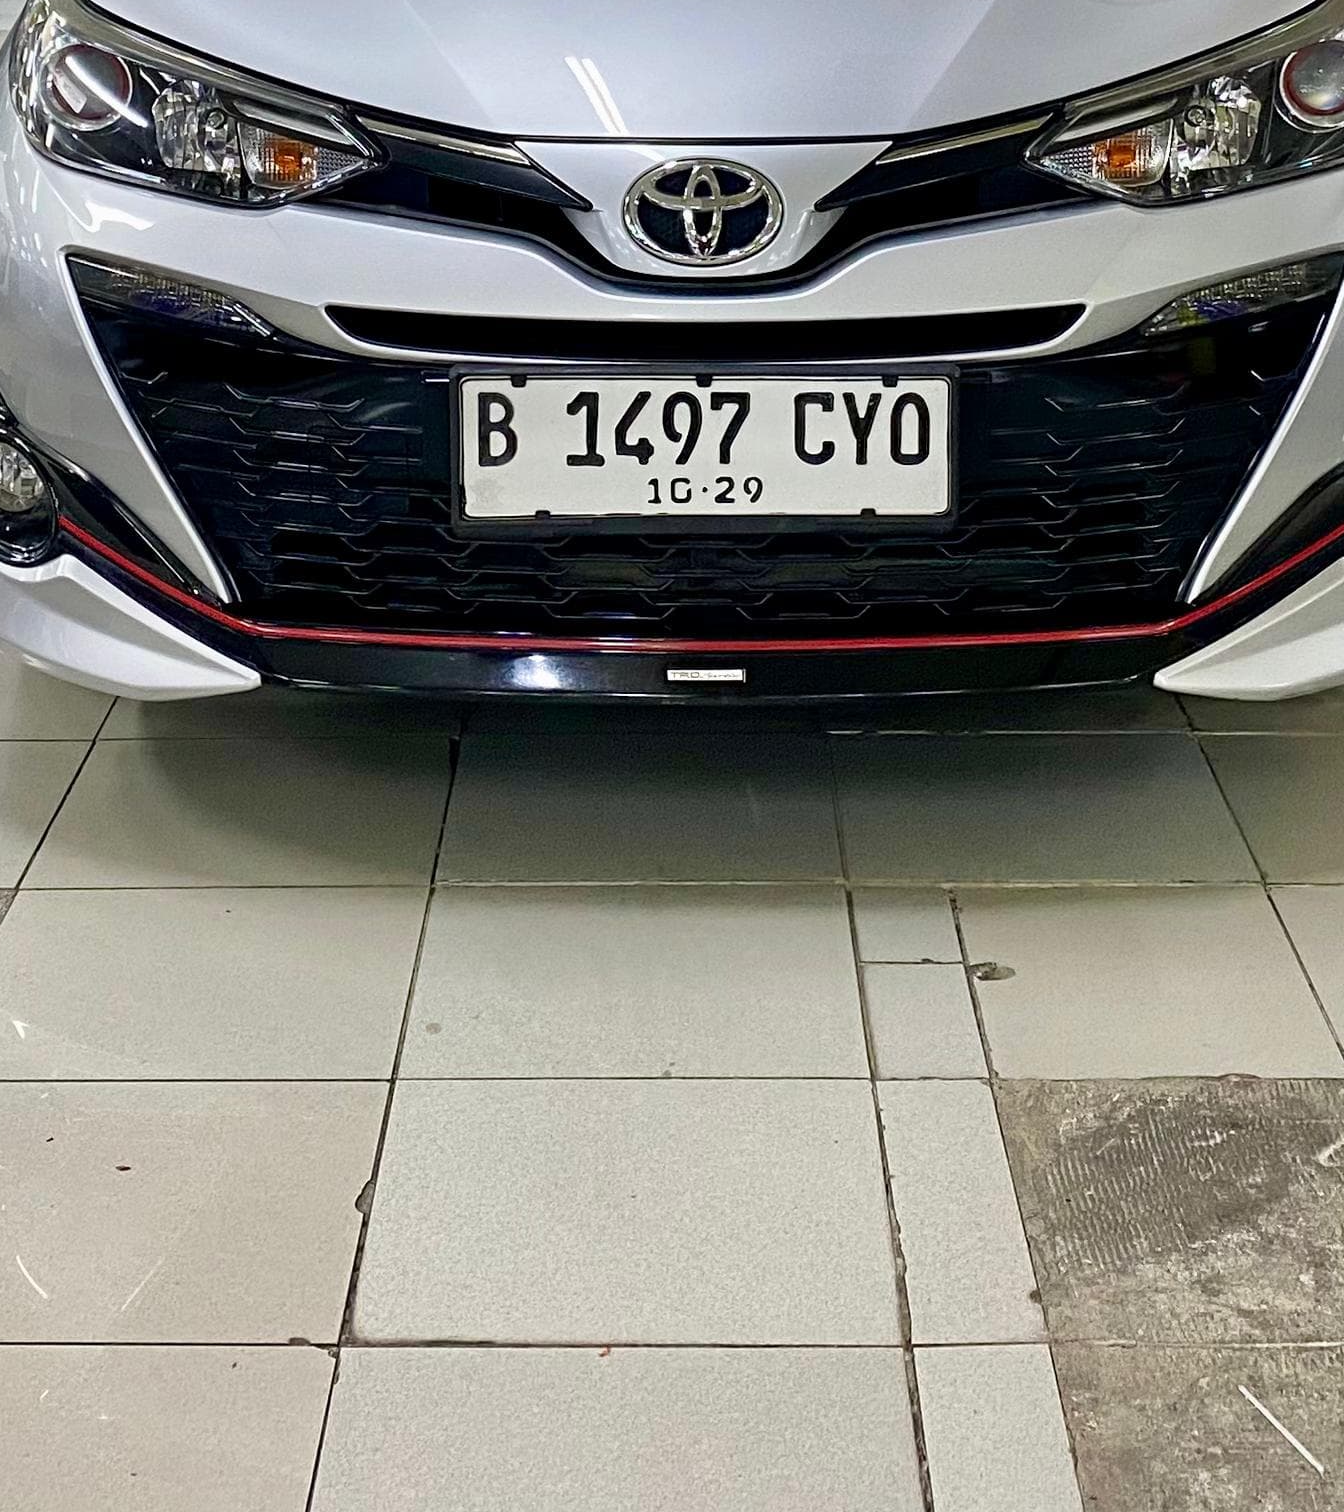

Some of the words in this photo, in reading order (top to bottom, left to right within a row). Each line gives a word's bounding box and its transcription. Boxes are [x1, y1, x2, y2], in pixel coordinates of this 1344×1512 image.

[477, 391, 518, 468] B
[564, 391, 752, 467] 1497
[793, 392, 931, 467] CYO
